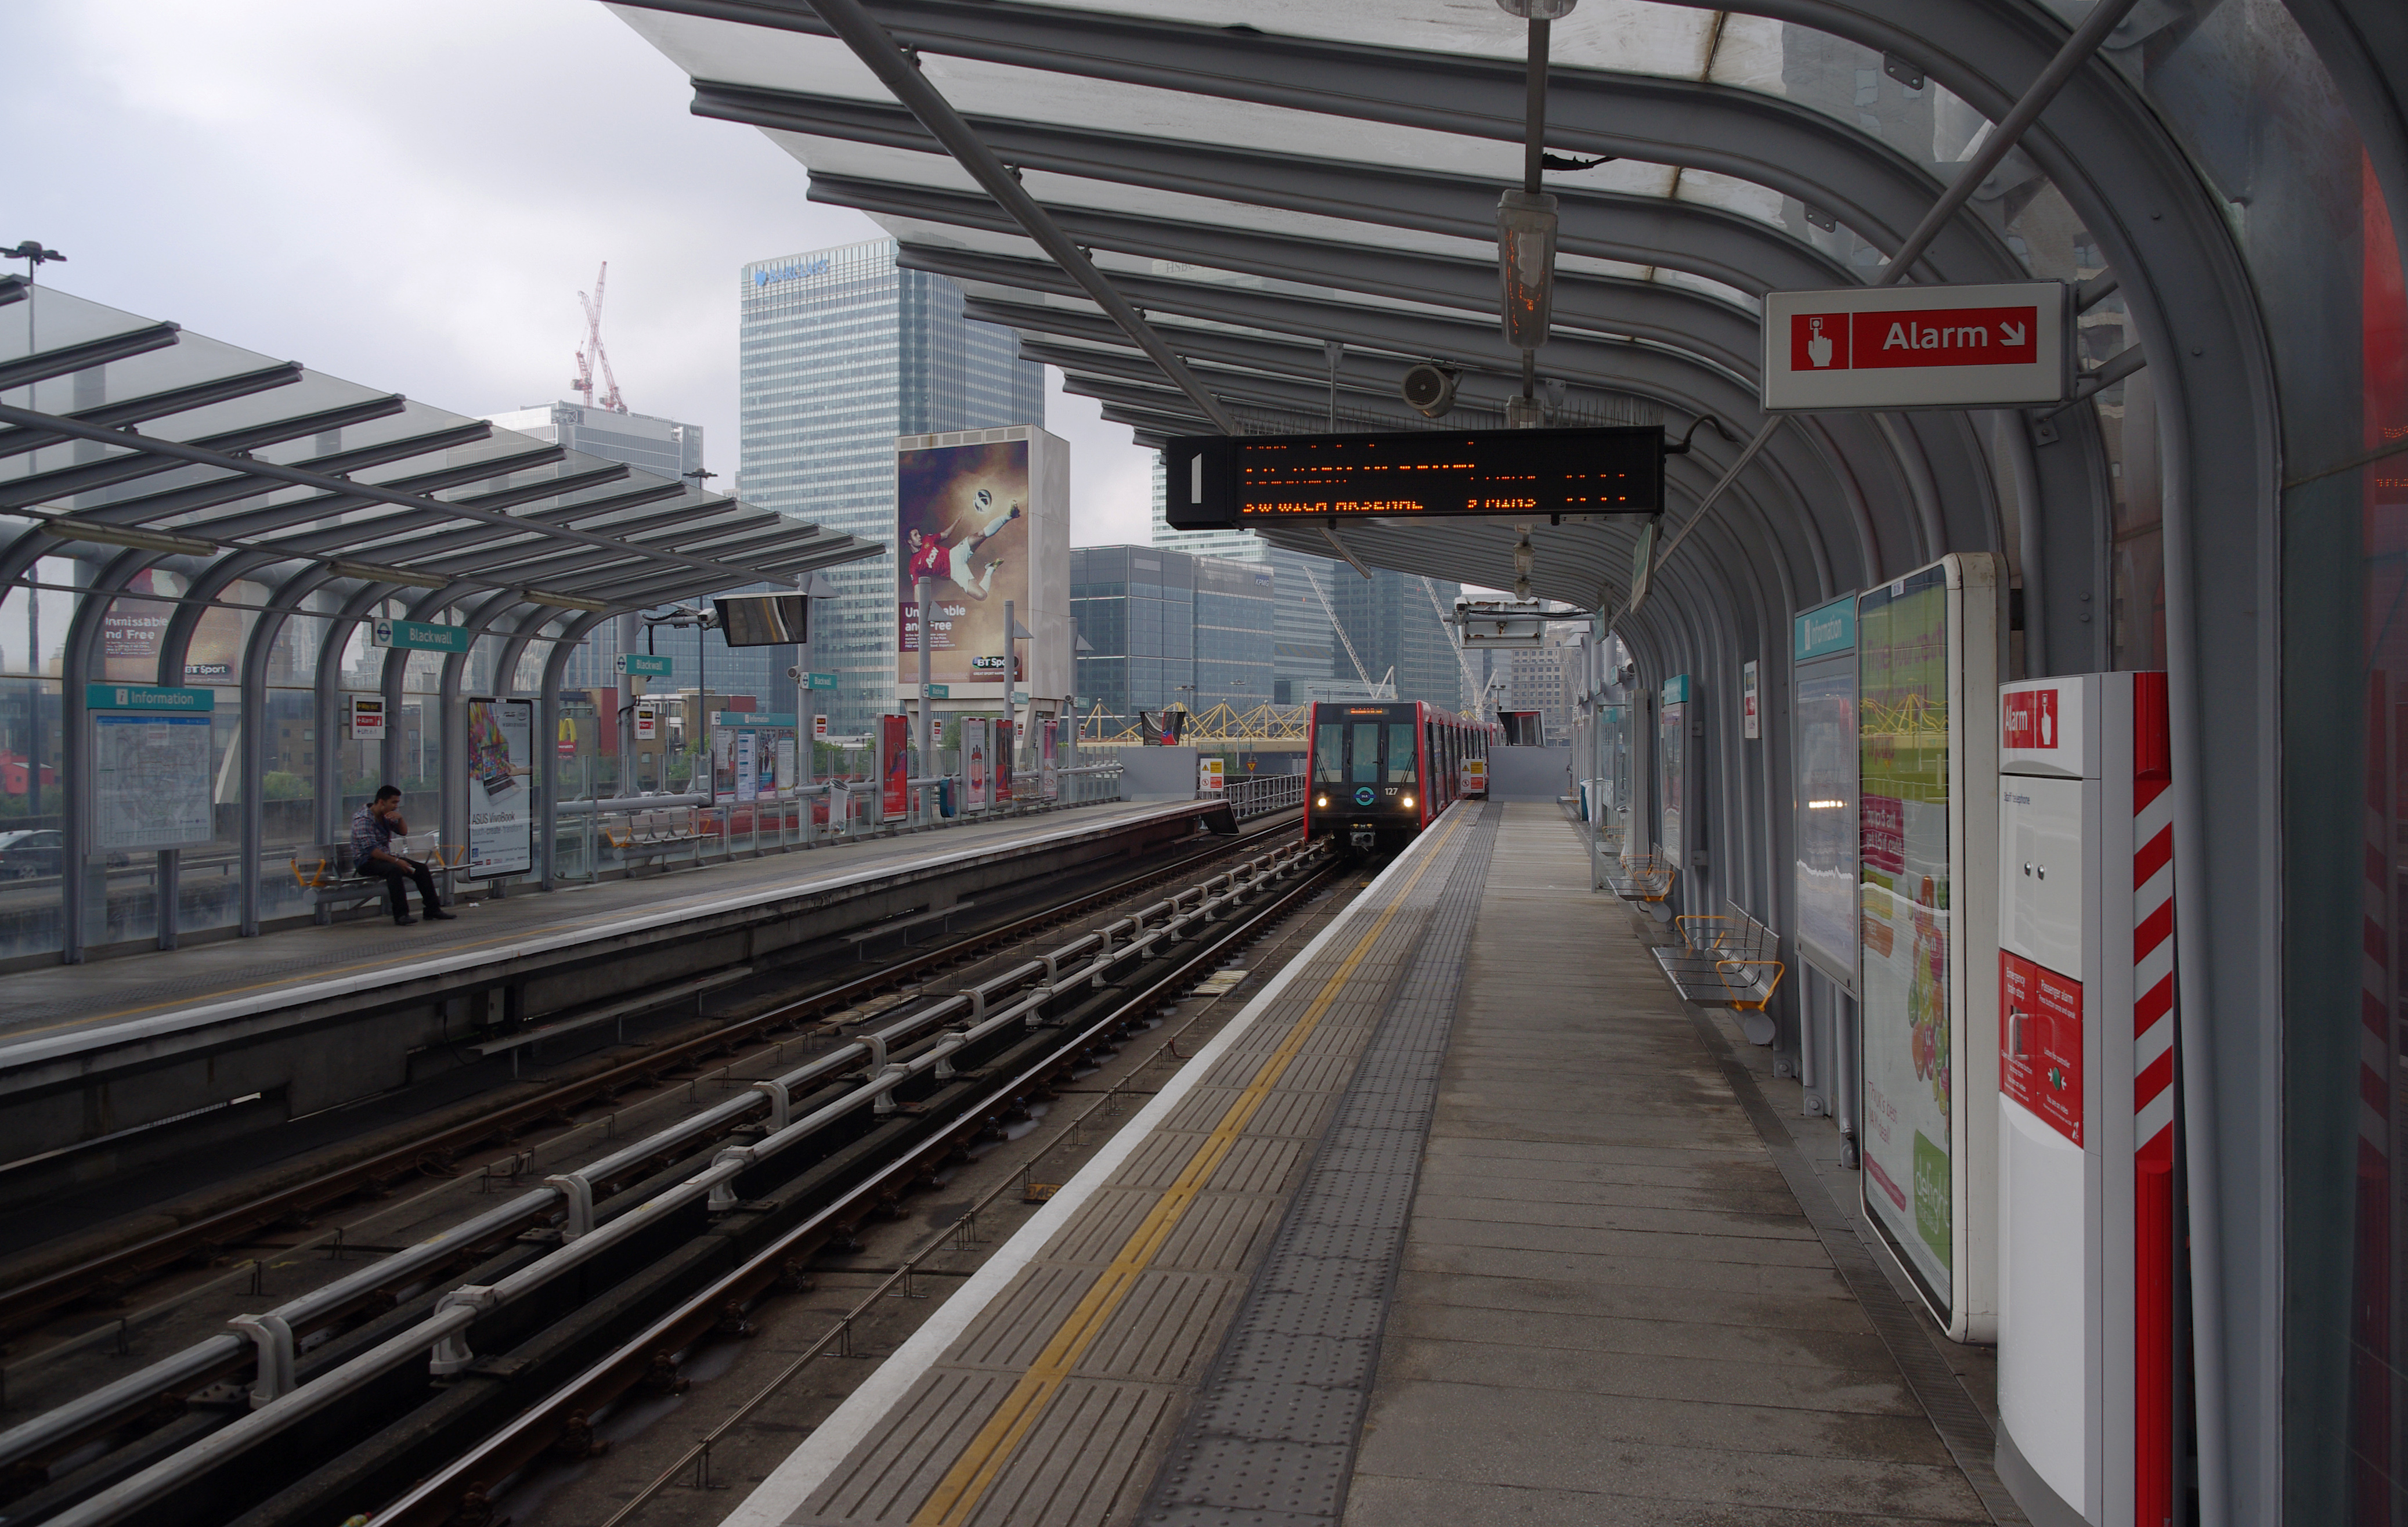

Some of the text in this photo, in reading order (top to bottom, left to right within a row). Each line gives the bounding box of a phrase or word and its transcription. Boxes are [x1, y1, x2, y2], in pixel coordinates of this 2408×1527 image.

[770, 259, 828, 283] BARCLAYS
[1883, 321, 1988, 351] Alarm
[1191, 452, 1202, 504] 1
[925, 547, 939, 569] AON
[905, 605, 966, 618] Unable
[106, 629, 155, 639] nd Free
[409, 627, 453, 644] Blackwall
[905, 623, 919, 631] an
[1810, 613, 1842, 645] Information
[200, 665, 226, 674] Sport
[636, 659, 663, 670] Blackwall
[991, 658, 1005, 667] Spo
[814, 677, 832, 685] Blackwall
[131, 691, 194, 705] Information
[2005, 705, 2028, 731] Alarm
[2012, 793, 2030, 806] telephone
[472, 811, 515, 825] ASUS VivoBook
[2006, 967, 2026, 987] Emergency
[2008, 983, 2025, 1001] train stop
[2041, 979, 2073, 1005] Passenger alarm
[2046, 998, 2055, 1009] button
[2067, 1010, 2076, 1019] speak
[2044, 1046, 2052, 1058] Listen
[2056, 1054, 2071, 1068] controller
[2060, 1104, 2068, 1115] video
[1916, 1153, 1949, 1234] delight
